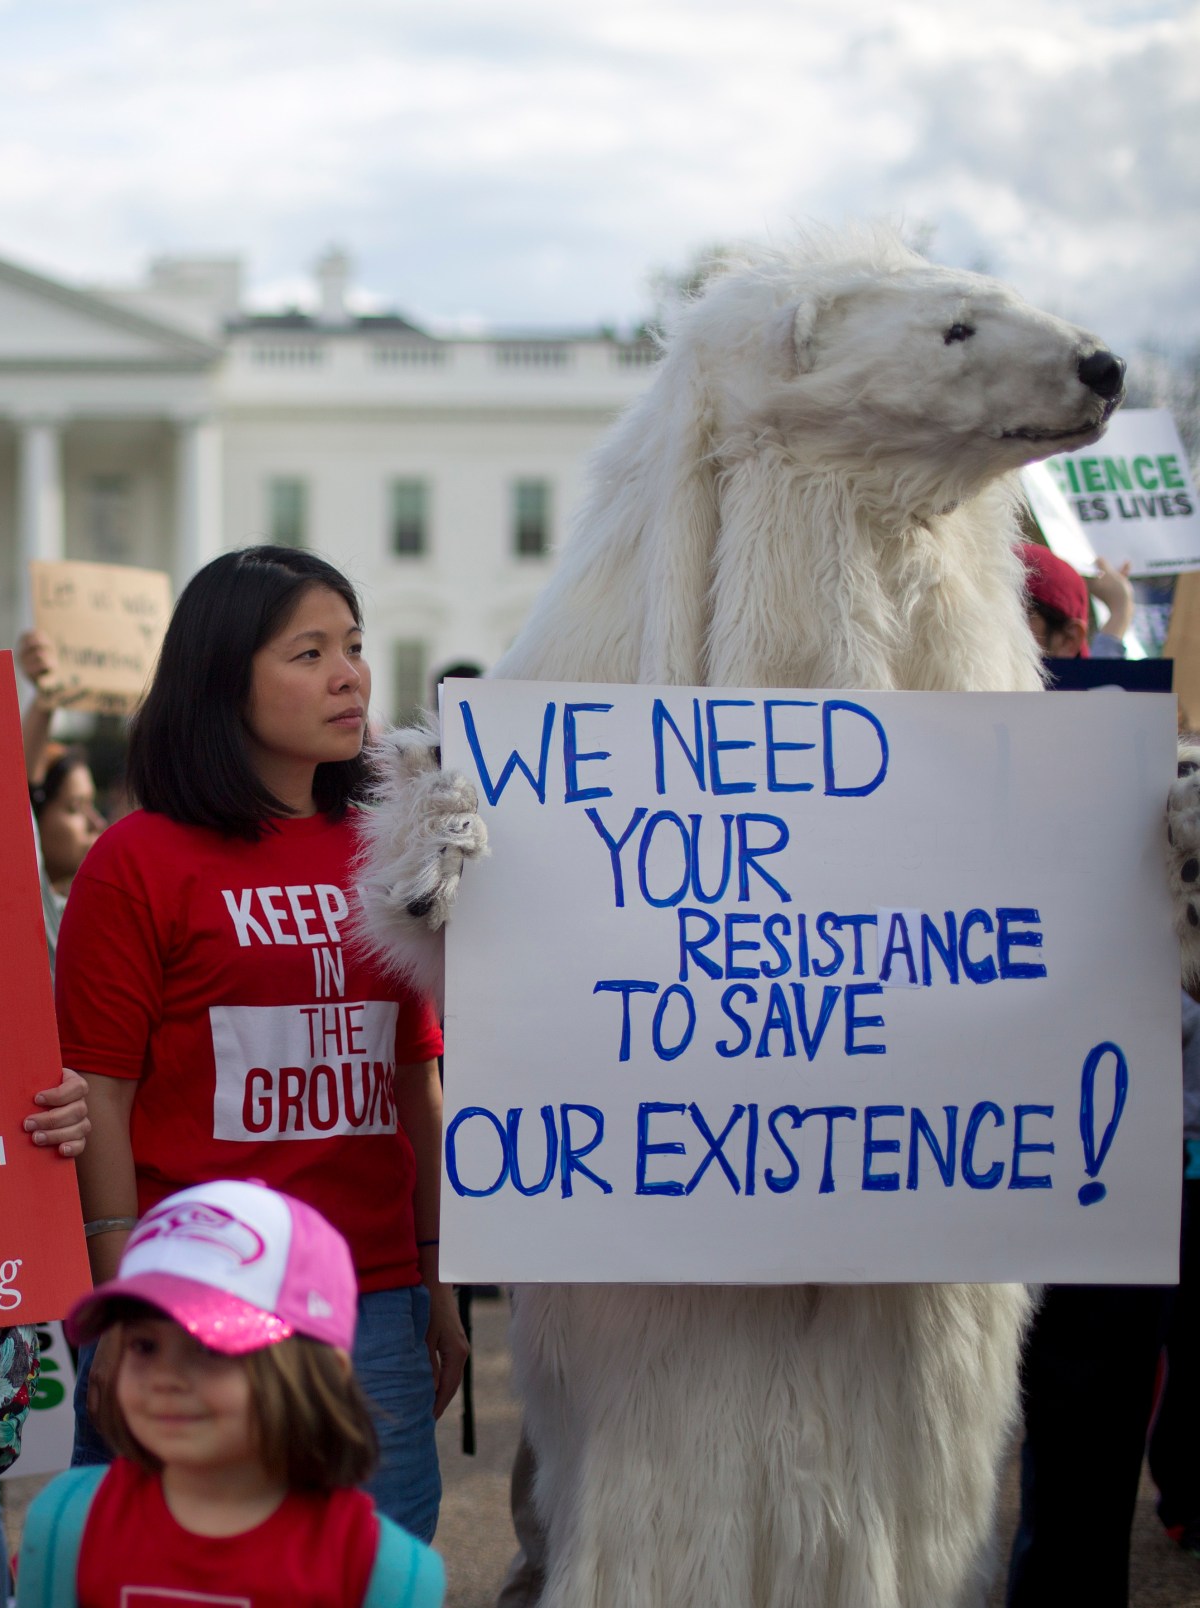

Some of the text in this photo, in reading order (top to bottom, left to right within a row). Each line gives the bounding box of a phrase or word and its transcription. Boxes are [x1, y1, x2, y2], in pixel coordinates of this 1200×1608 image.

[1117, 493, 1193, 518] LIVES
[459, 699, 889, 806] WE NEED
[586, 807, 791, 908] YOUR
[221, 884, 350, 947] KEEP
[678, 906, 1047, 987] RESISTANCE
[312, 947, 345, 997] IN
[300, 1005, 367, 1058] THE
[593, 980, 886, 1062] TO SAVE
[242, 1062, 397, 1134] GROUN
[445, 1103, 613, 1199] OUR
